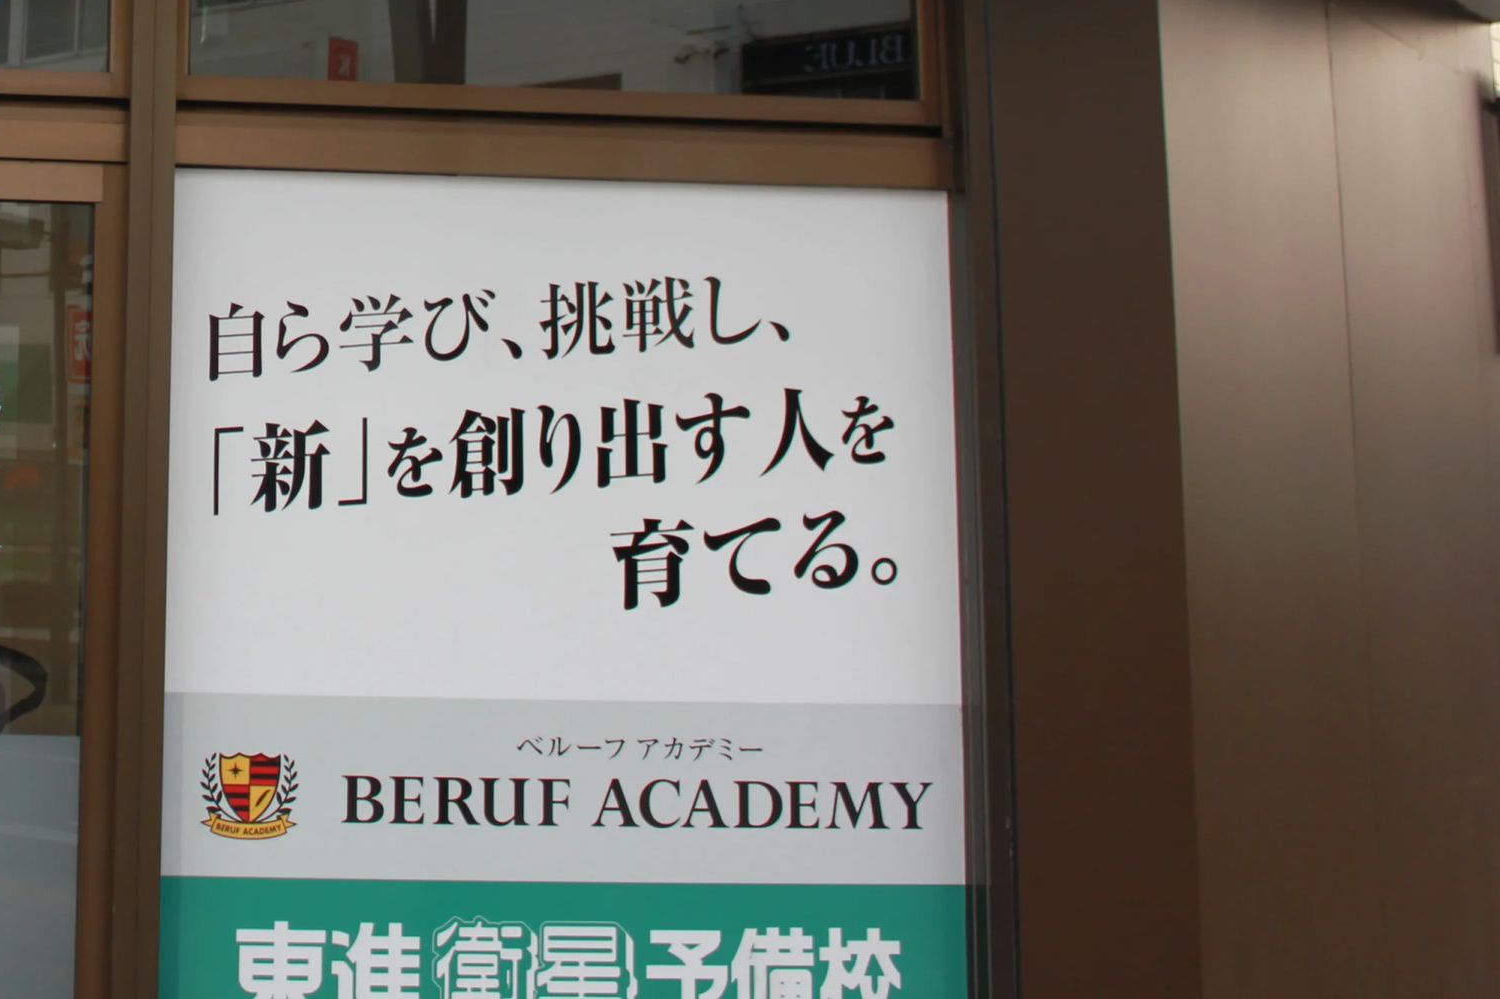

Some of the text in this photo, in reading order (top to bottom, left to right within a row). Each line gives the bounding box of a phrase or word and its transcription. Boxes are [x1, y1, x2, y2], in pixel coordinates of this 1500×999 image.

[208, 274, 792, 383] 自ら学び、挑戦し、
[211, 387, 896, 517] 「新」を創り出す人を
[609, 508, 898, 610] 育てる。
[516, 734, 764, 762] ベルーフ アカデミー
[215, 822, 282, 835] BERUF ACADEMY
[341, 774, 934, 832] BERUF ACADEMY
[235, 916, 902, 999] 東進衛星予備校
